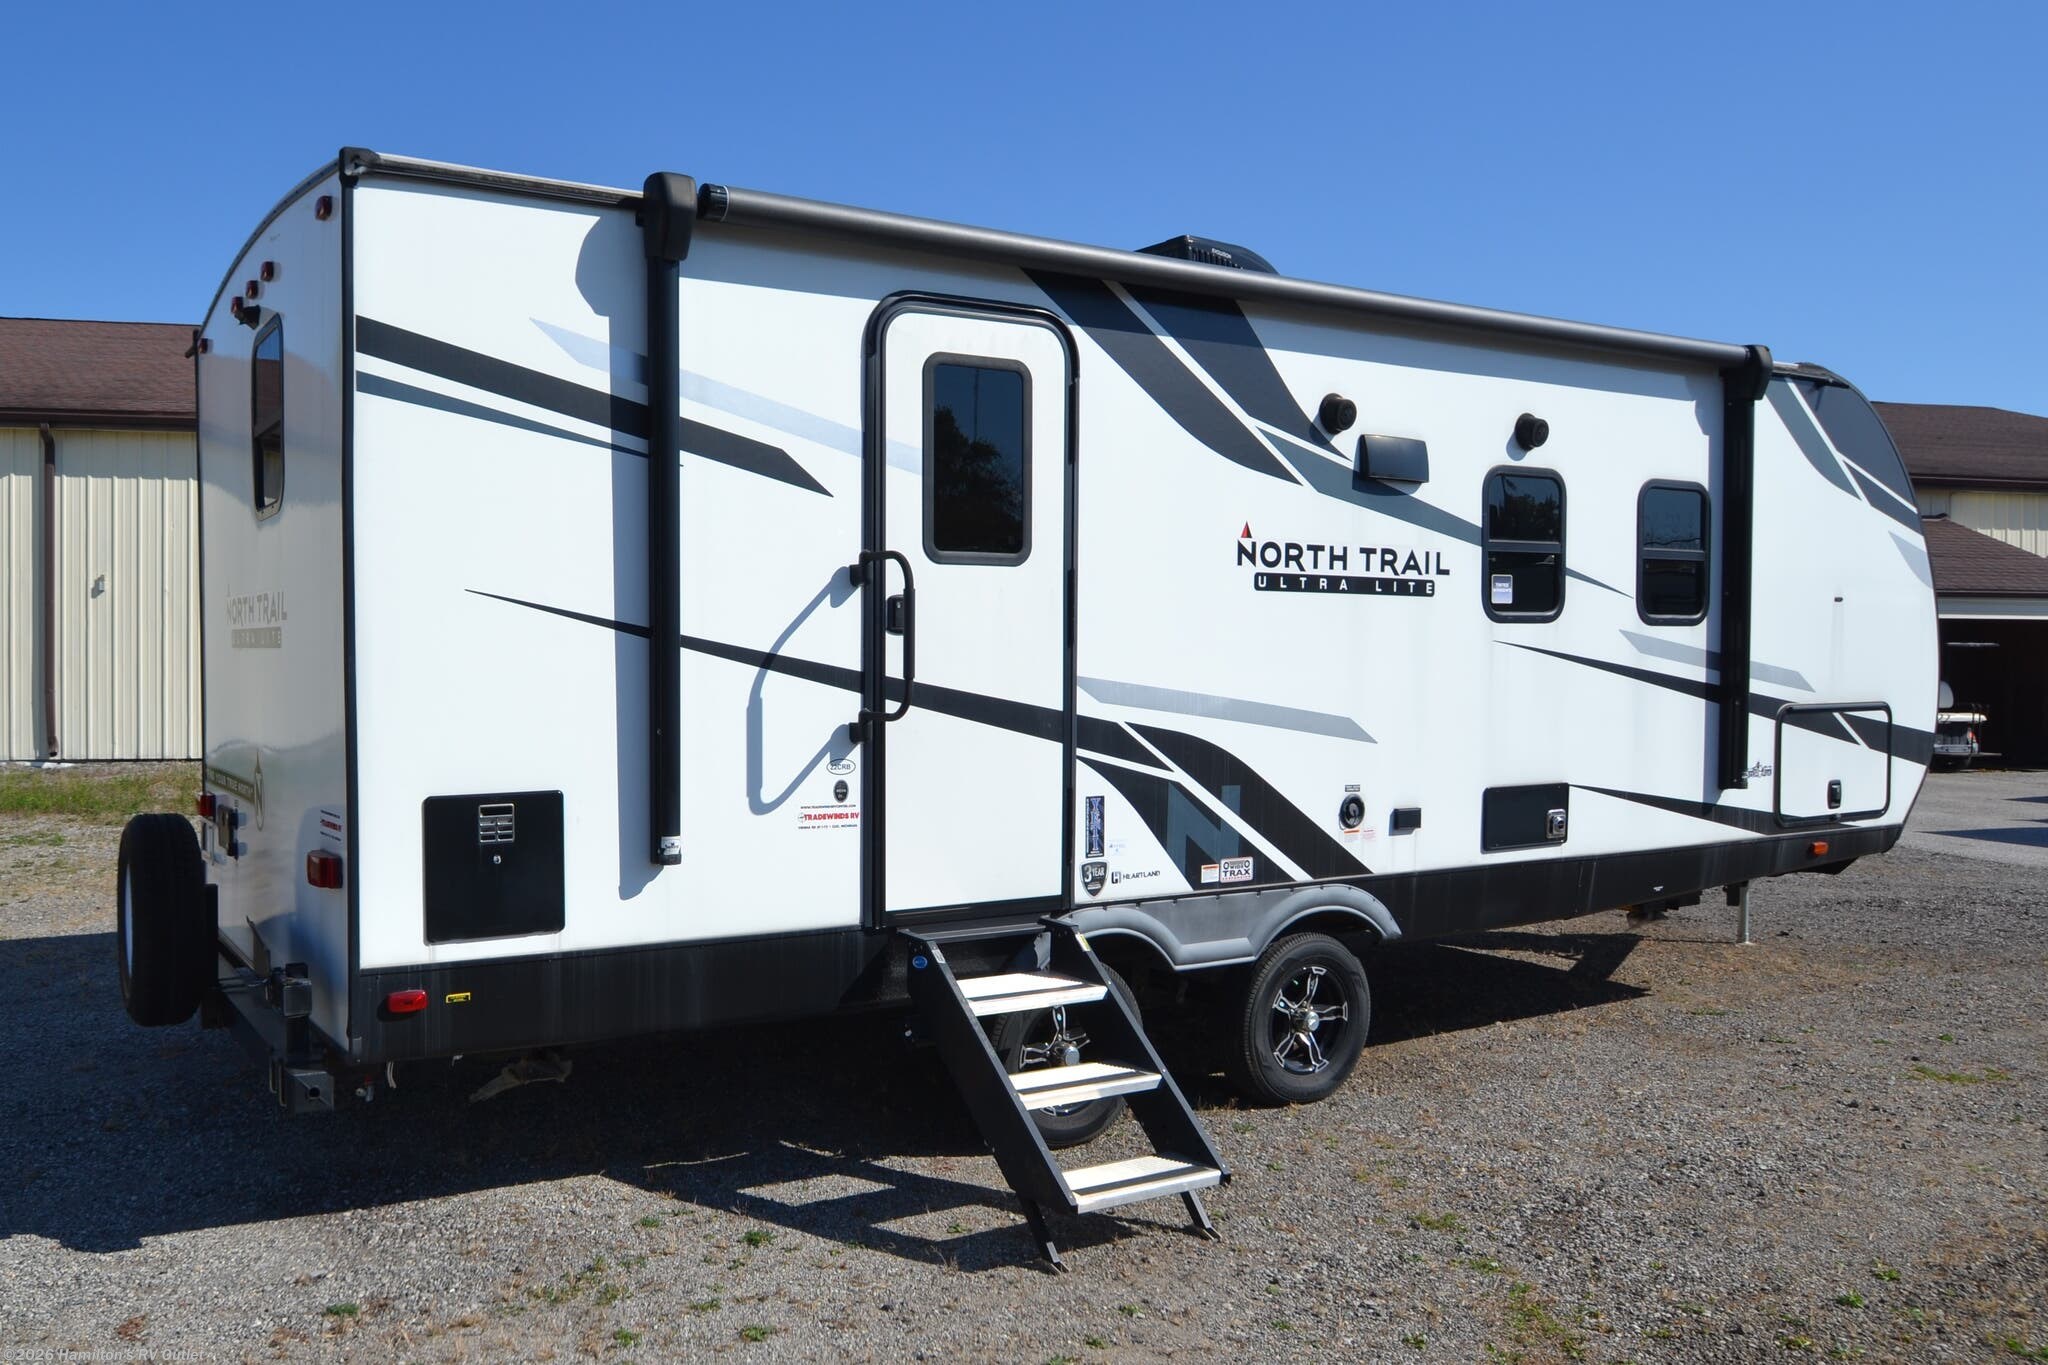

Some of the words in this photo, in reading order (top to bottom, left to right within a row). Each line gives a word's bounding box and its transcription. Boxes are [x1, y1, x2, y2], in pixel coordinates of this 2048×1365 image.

[1237, 539, 1348, 572] NORTH
[1359, 546, 1450, 576] TRAIL
[1257, 575, 1349, 591] ULTRA
[1375, 579, 1434, 594] LITE
[226, 594, 255, 627] NORTH
[256, 591, 287, 624] TRAIL
[1083, 865, 1092, 882] 3
[1091, 866, 1105, 877] YEAR
[1122, 870, 1161, 880] HEARTLAND
[1222, 869, 1250, 877] TRAX
